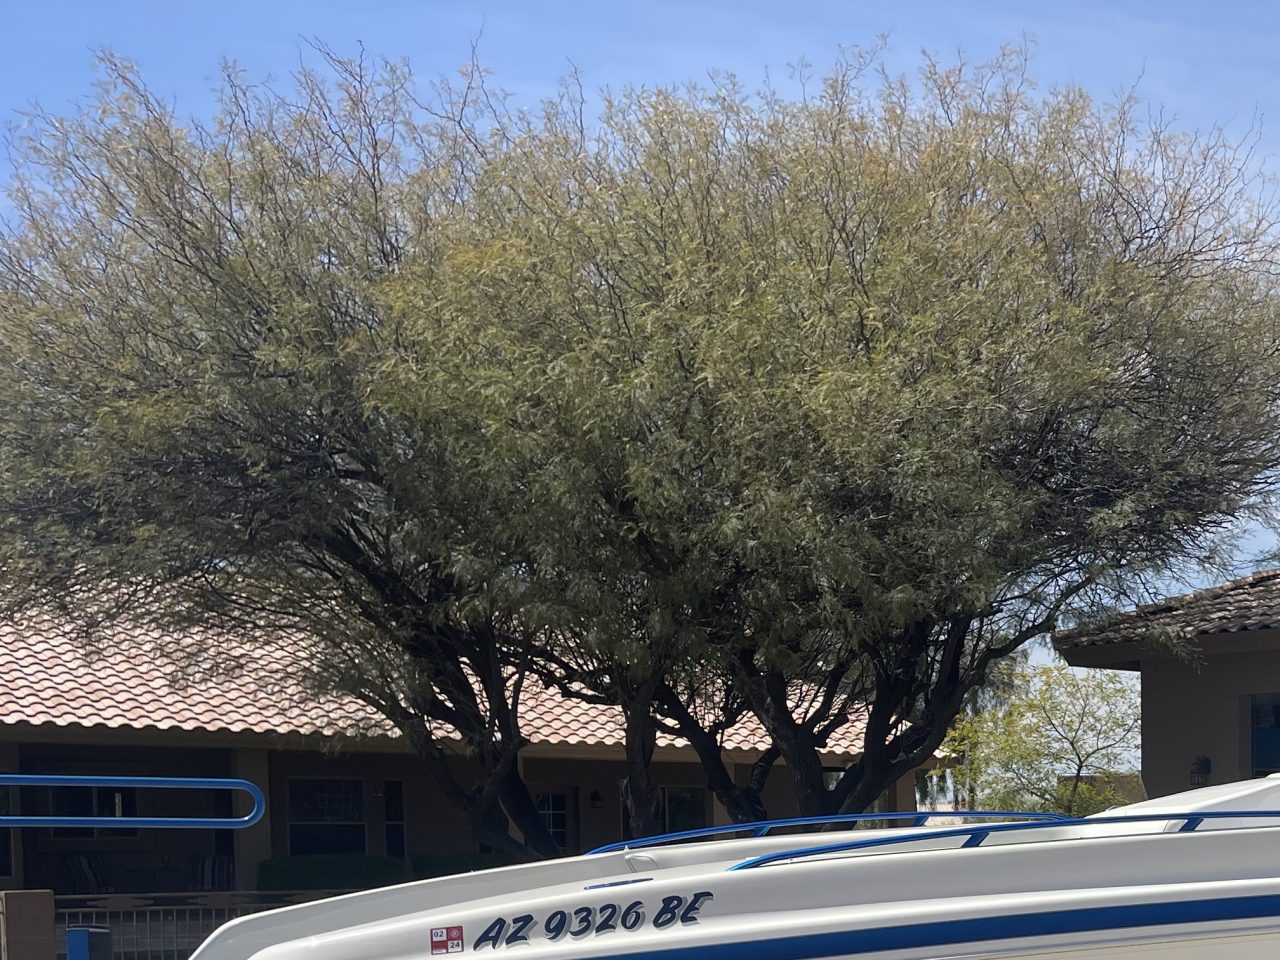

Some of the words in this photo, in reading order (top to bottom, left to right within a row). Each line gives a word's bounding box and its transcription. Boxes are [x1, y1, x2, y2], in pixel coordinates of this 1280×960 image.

[473, 913, 537, 952] AZ
[544, 900, 647, 941] 9326
[652, 891, 714, 930] BE
[433, 930, 444, 938] 02
[449, 941, 460, 949] 24
